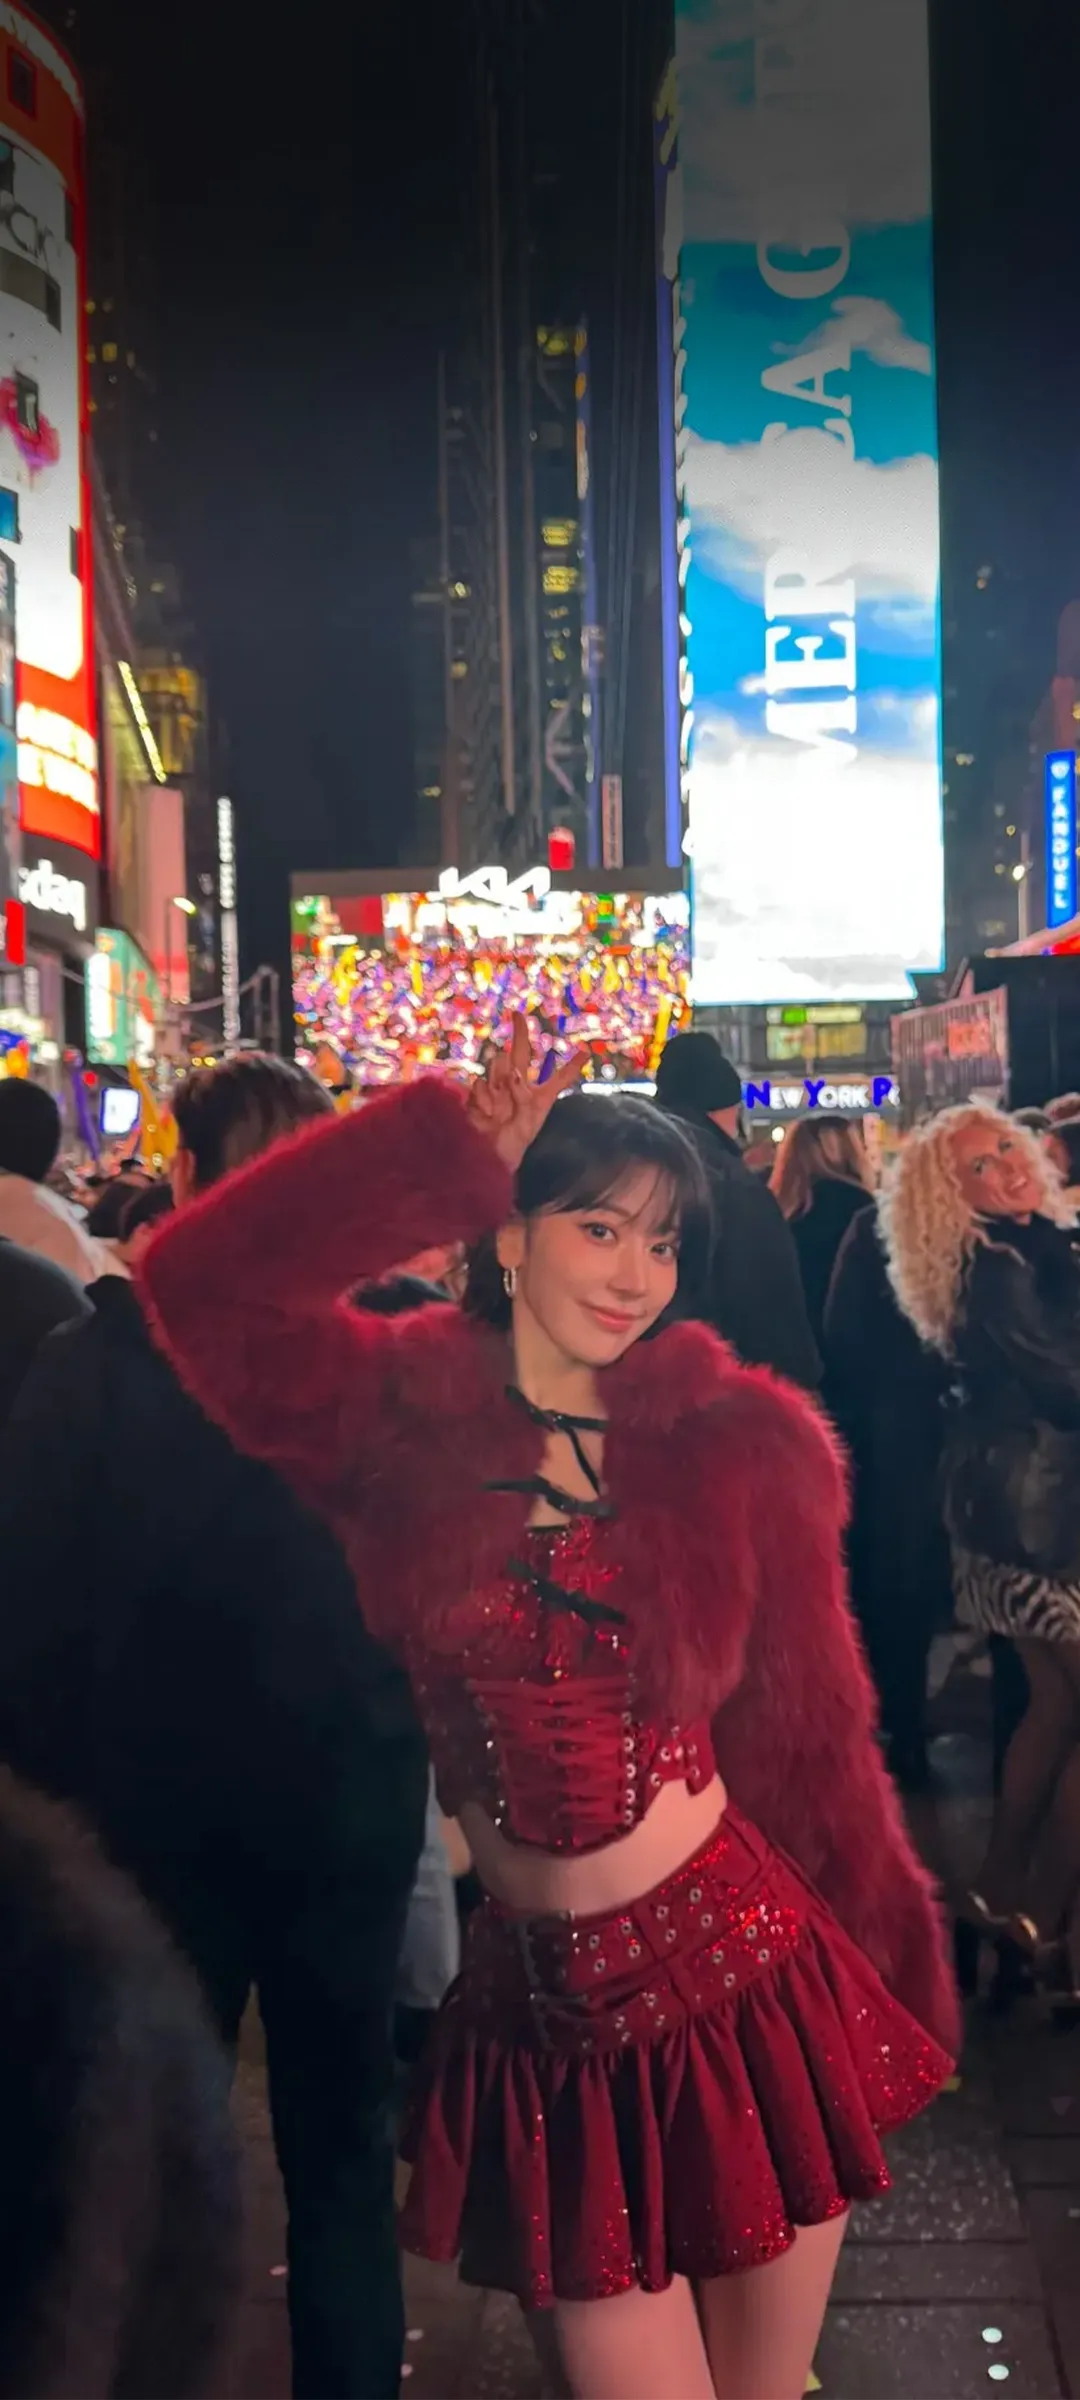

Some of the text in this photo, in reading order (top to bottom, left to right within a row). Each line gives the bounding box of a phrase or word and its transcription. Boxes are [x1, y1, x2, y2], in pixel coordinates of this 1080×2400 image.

[1052, 786, 1070, 909] FANDUEL
[746, 1080, 803, 1110] NEW
[804, 1079, 869, 1108] YORK
